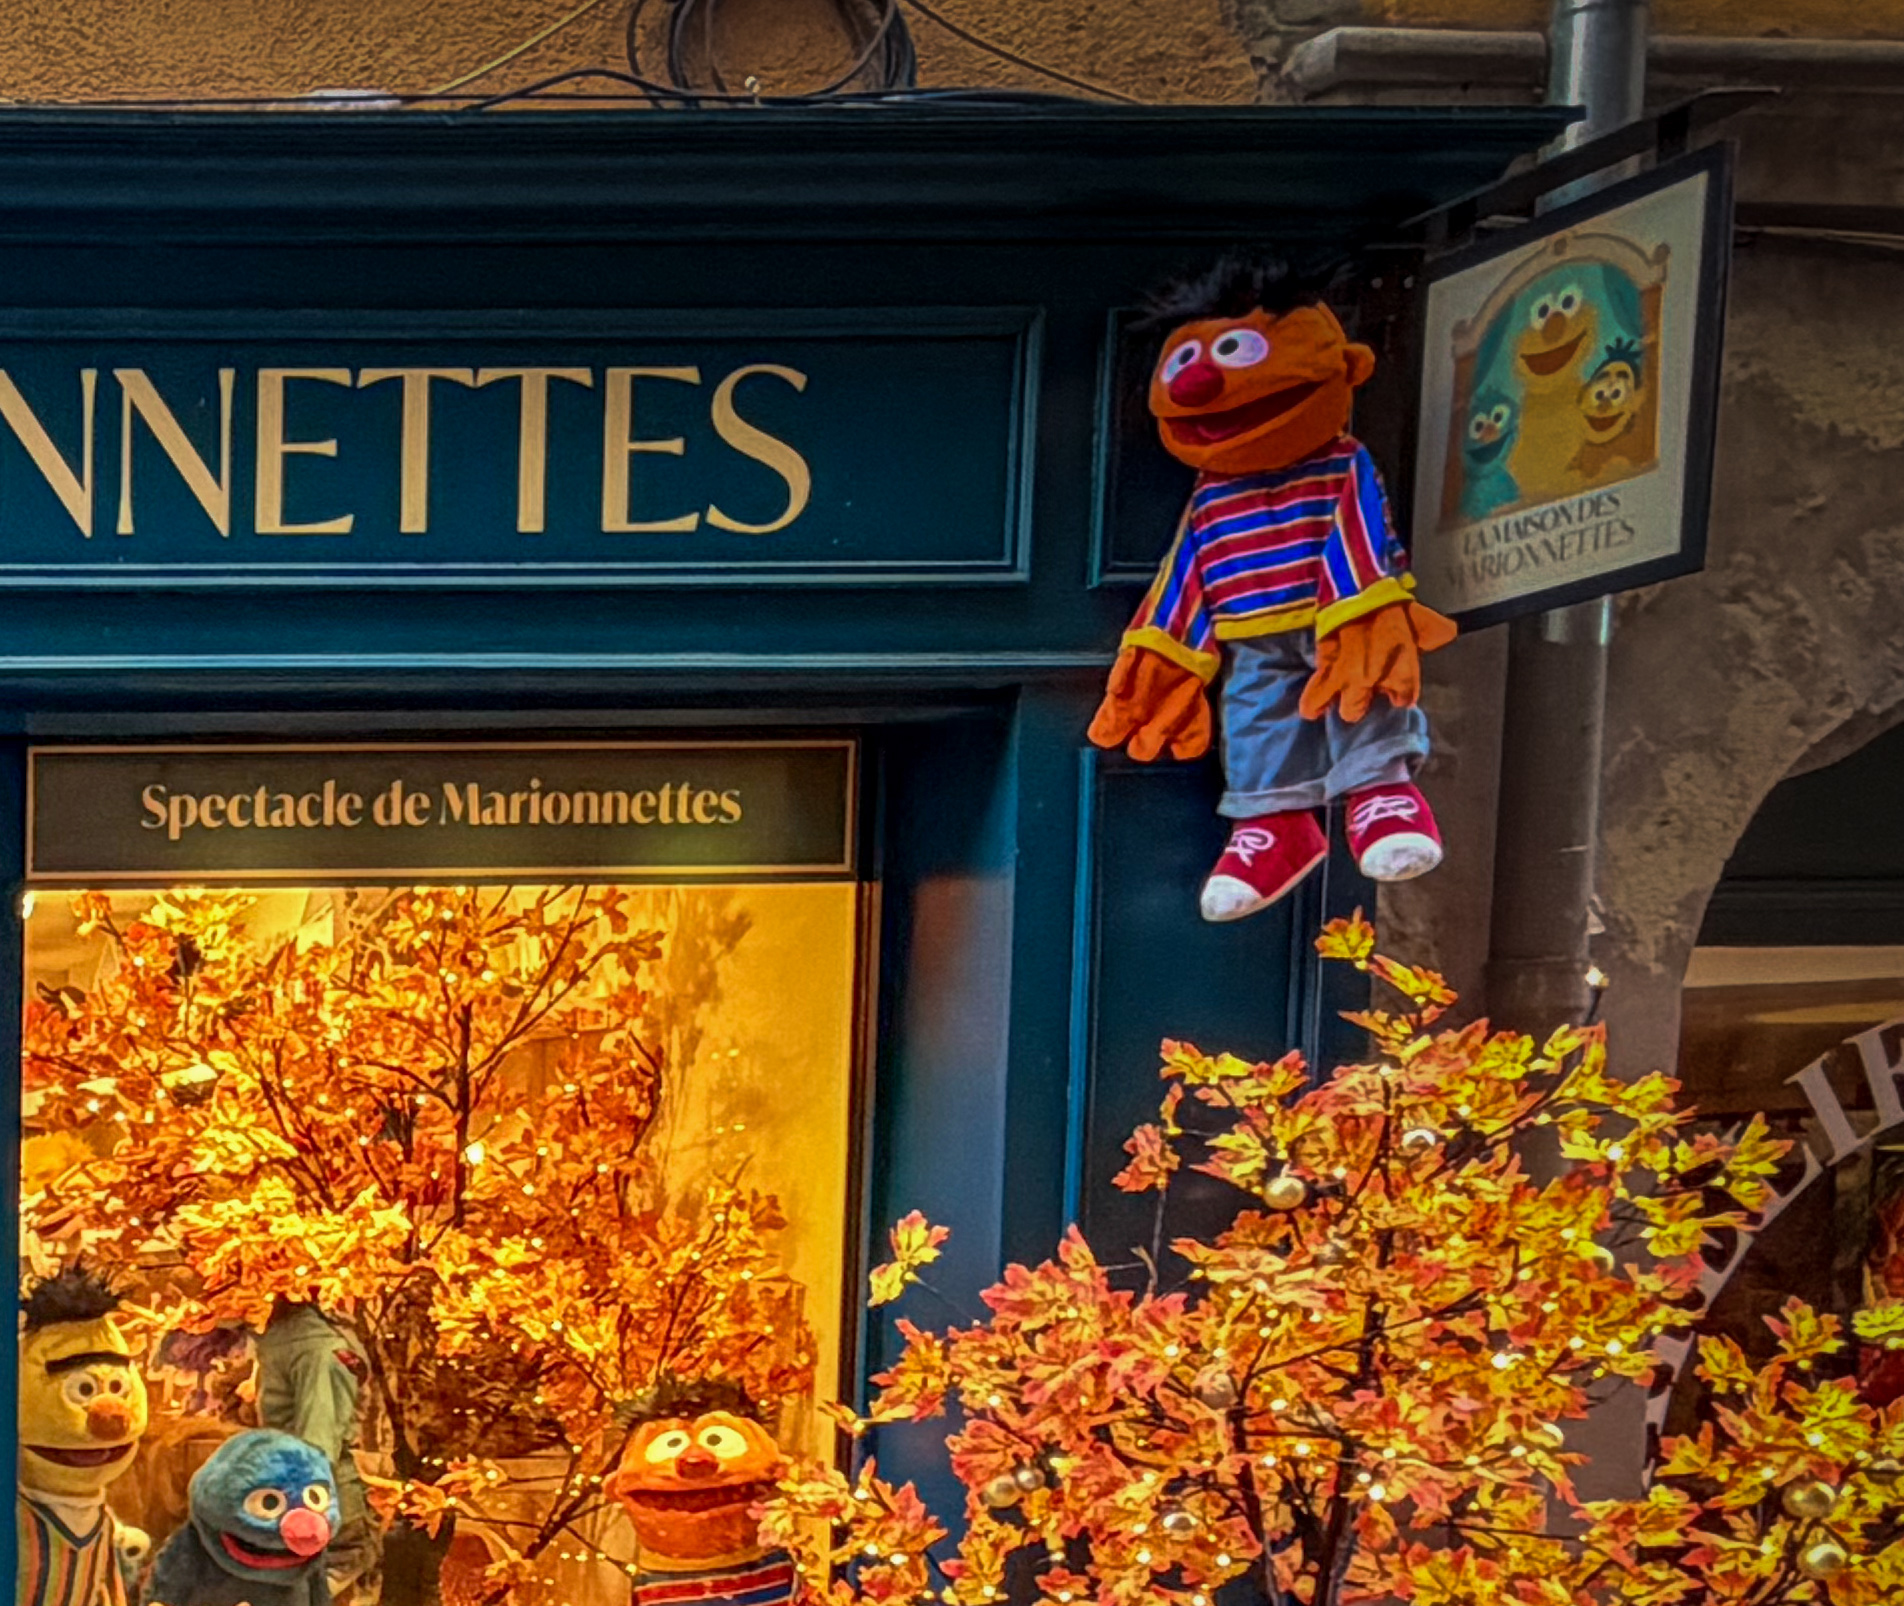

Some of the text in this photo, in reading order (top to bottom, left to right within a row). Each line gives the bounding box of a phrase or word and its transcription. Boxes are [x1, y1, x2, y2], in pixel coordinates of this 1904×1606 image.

[1490, 503, 1573, 546] MAISON
[1575, 493, 1621, 523] DES
[1445, 518, 1635, 590] MARIONNETTES
[140, 778, 742, 840] Spectacle de Marionnettes
